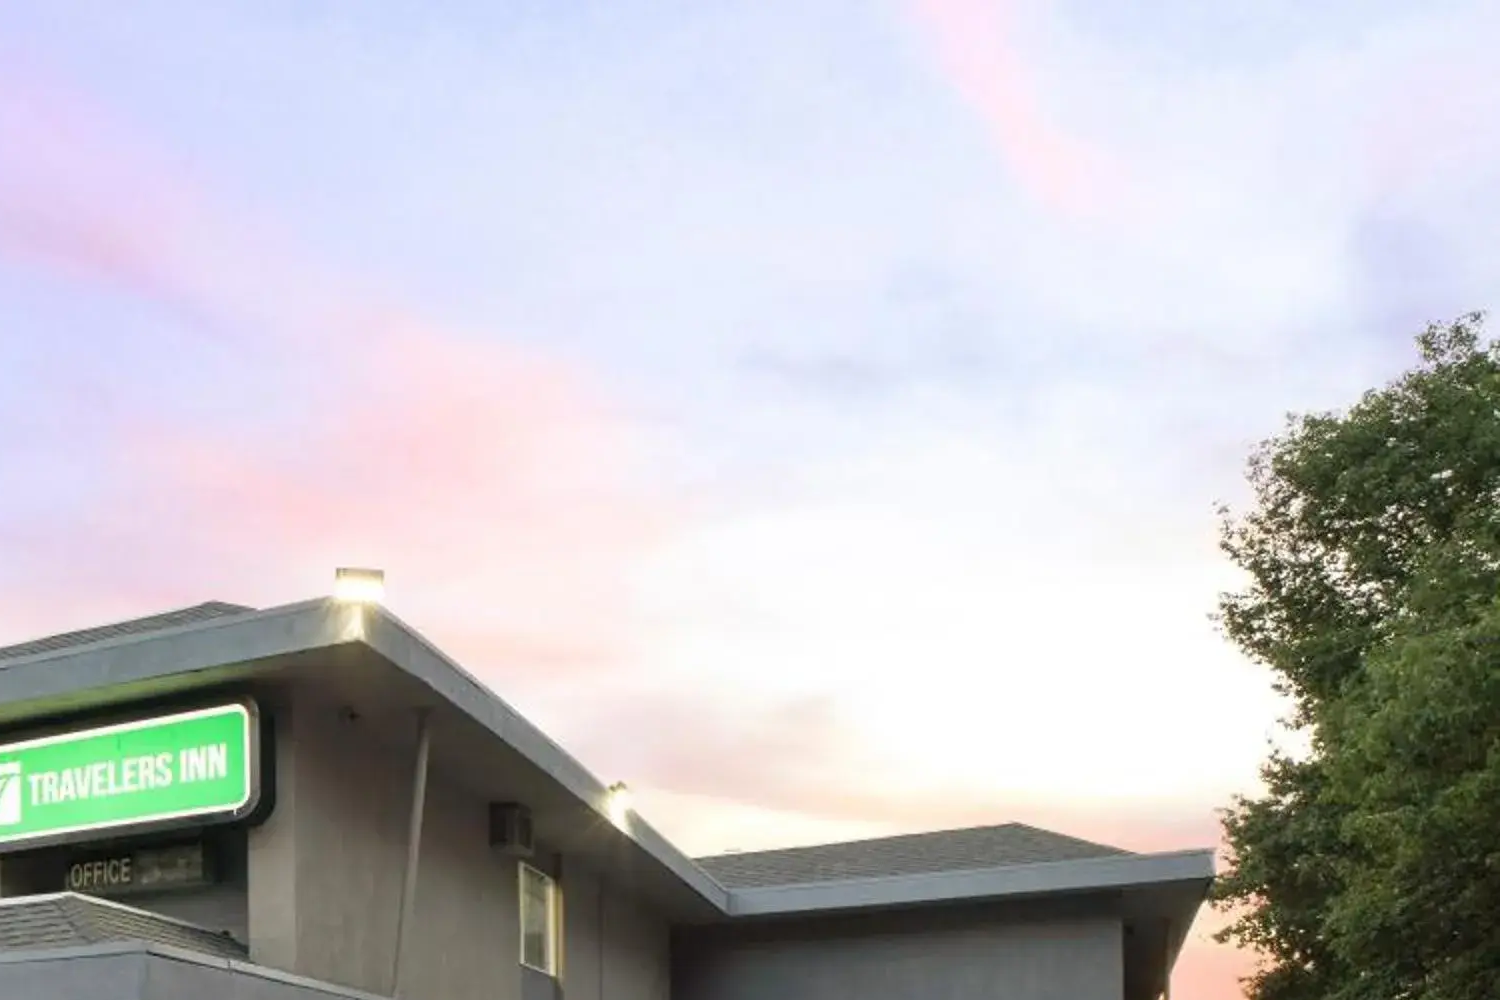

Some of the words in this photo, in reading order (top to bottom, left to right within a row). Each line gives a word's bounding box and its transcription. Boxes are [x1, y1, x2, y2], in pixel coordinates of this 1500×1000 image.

[27, 752, 173, 806] TRAVELERS
[180, 743, 227, 783] INN
[70, 858, 131, 887] OFFICE
